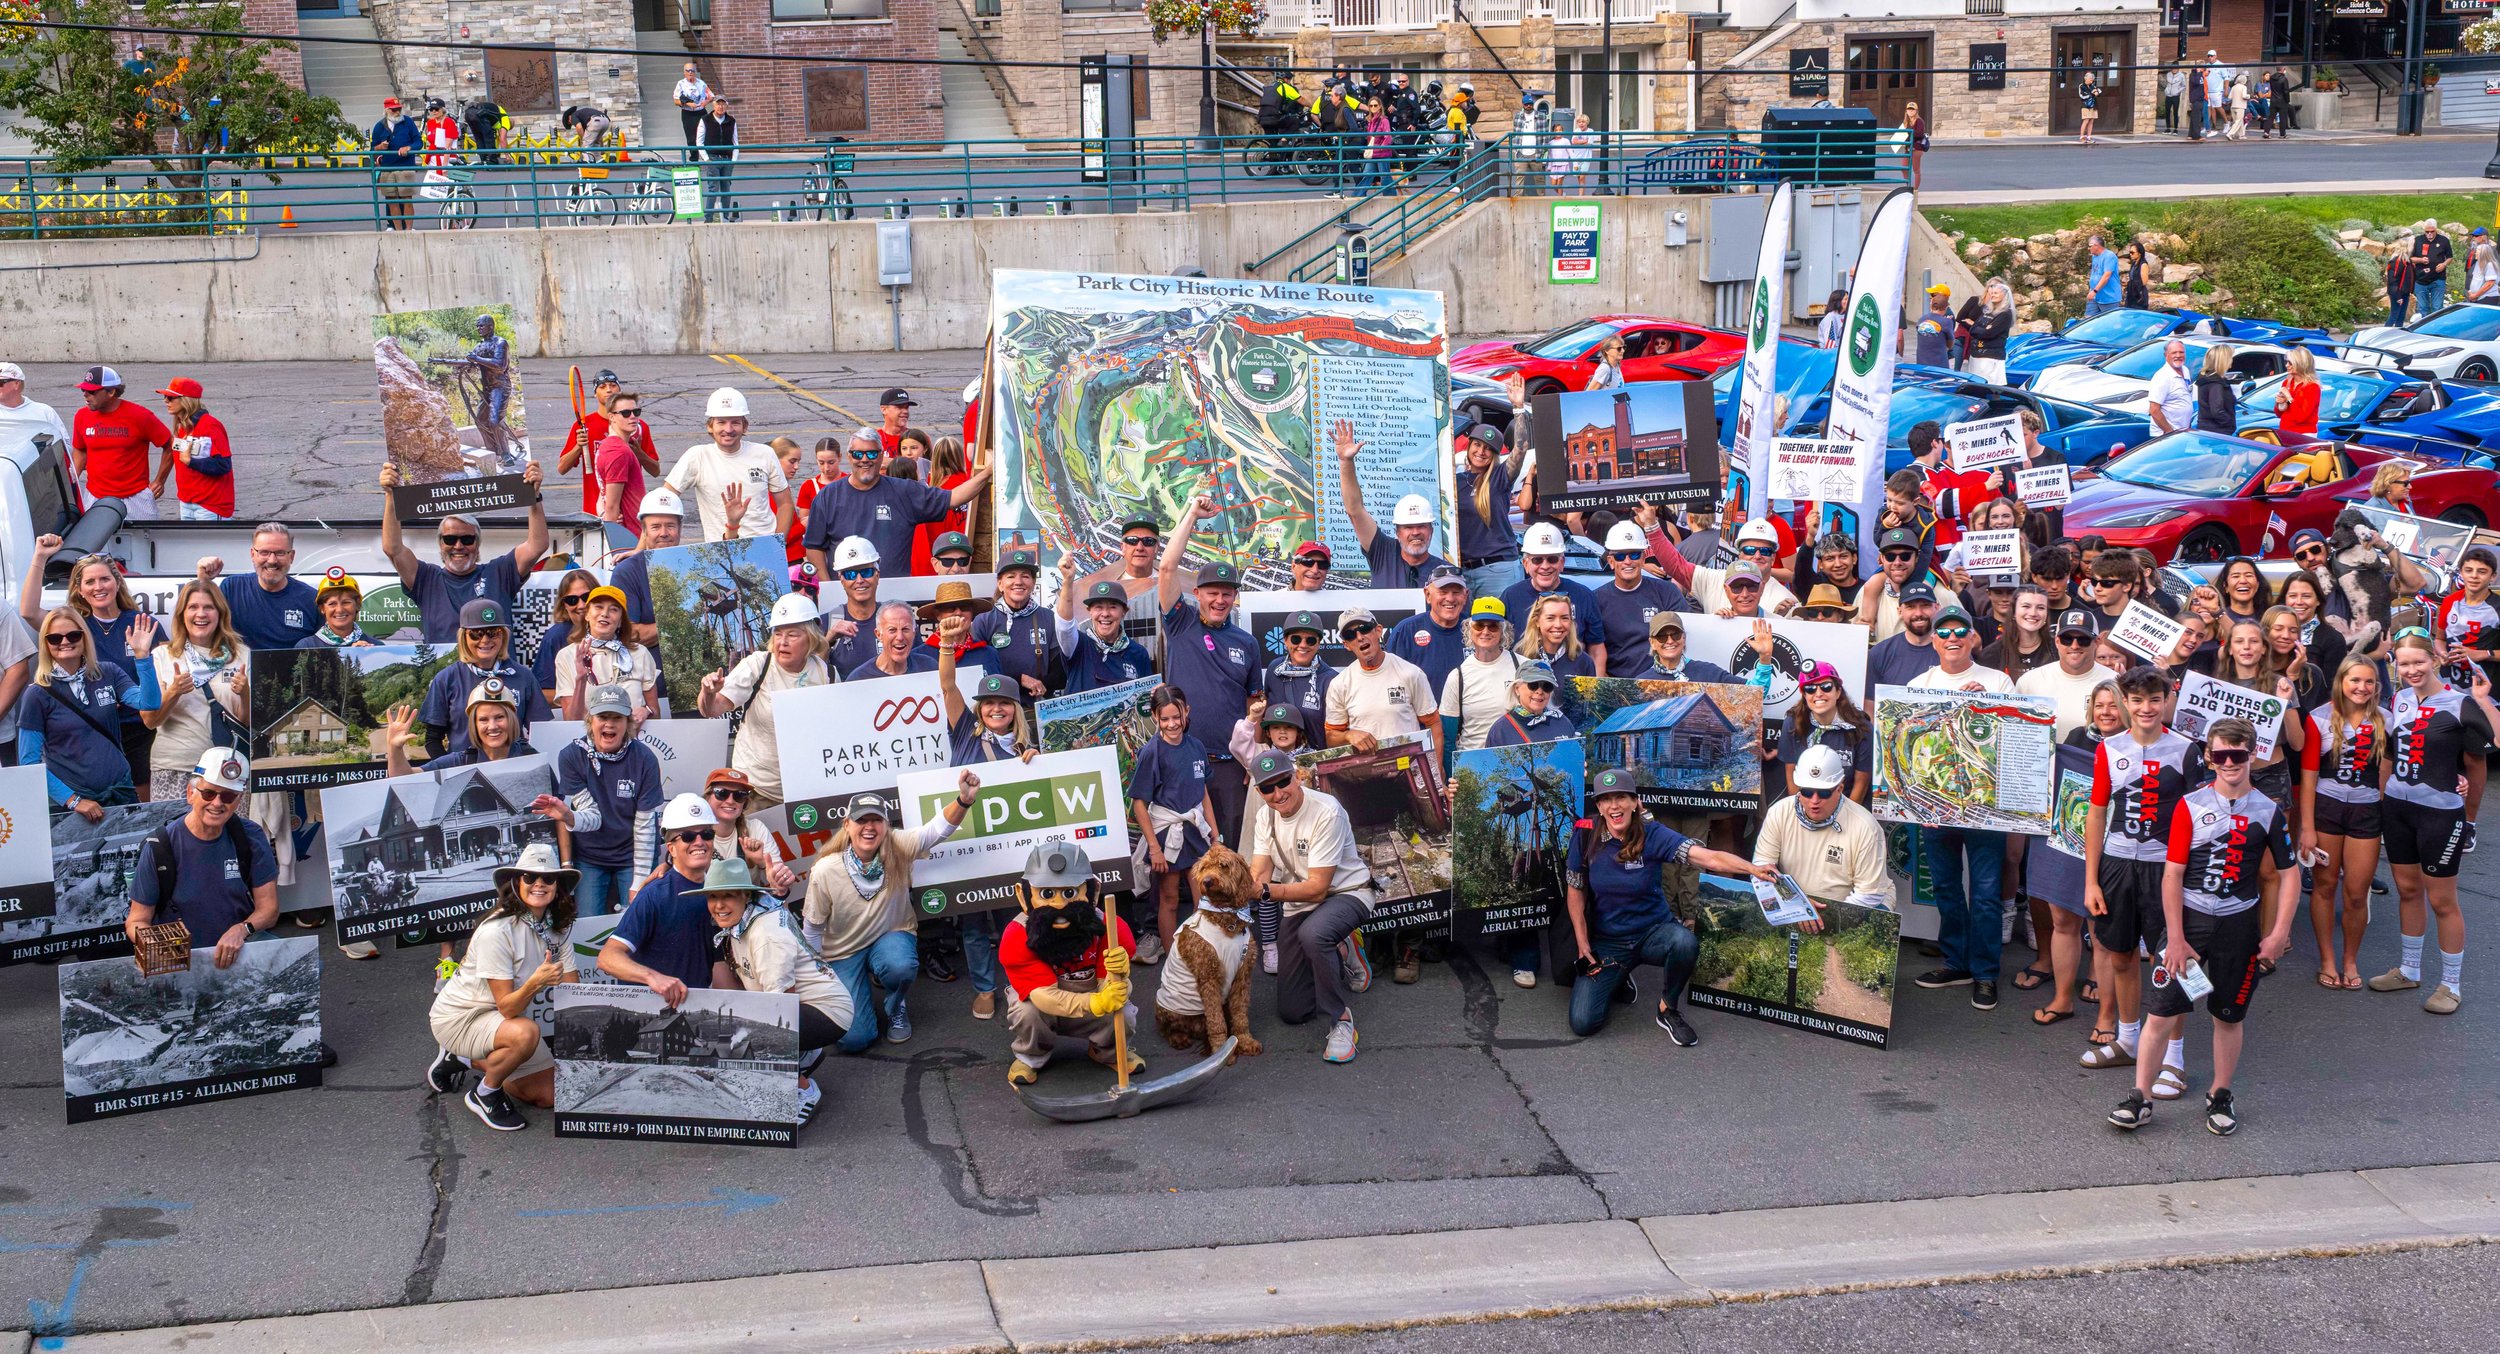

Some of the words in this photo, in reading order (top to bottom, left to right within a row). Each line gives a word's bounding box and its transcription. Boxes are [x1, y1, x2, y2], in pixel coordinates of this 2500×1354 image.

[1557, 218, 1595, 226] BREWPUB
[1077, 275, 1124, 291] Park
[1129, 278, 1170, 295] City
[1176, 280, 1255, 297] Historic
[1260, 284, 1311, 301] Mine
[1316, 288, 1375, 303] Route
[1248, 322, 1279, 333] Explore
[1280, 322, 1298, 330] Our
[1299, 319, 1321, 328] Silver
[1322, 318, 1351, 328] Mining
[1307, 330, 1339, 340] Heritage
[1355, 333, 1372, 344] This
[1374, 337, 1392, 349] New
[1346, 360, 1364, 368] City
[1367, 360, 1405, 368] Museum
[1324, 376, 1362, 384] Crescent
[1364, 377, 1405, 386] Tramway
[1387, 370, 1414, 378] Depot
[1324, 393, 1362, 401] Treasure
[1385, 396, 1427, 404] Trailhead
[1371, 404, 1412, 412] Overlook
[1975, 423, 1988, 431] STATE
[1989, 419, 2015, 428] CHAMPIONS
[1779, 442, 1815, 453] TOGETHER,
[1817, 444, 1828, 453] WE
[1829, 445, 1853, 455] CARRY
[1971, 437, 1997, 448] MINERS
[1778, 454, 1791, 463] THE
[1792, 455, 1819, 464] LEGACY
[1820, 456, 1856, 466] FORWARD.
[1966, 453, 1985, 463] BOYS
[1986, 448, 2015, 459] HOCKEY
[431, 488, 458, 498] HMR
[459, 484, 485, 494] SITE
[485, 482, 497, 491] #4
[2035, 478, 2060, 487] MINERS
[435, 499, 473, 512] MINER
[475, 494, 515, 507] STATUE
[1552, 500, 1575, 509] HMR
[1576, 498, 1597, 507] SITE
[1598, 497, 1608, 505] #1
[1616, 493, 1642, 503] PARK
[1642, 491, 1666, 501] CITY
[1668, 488, 1710, 499] MUSEUM
[2023, 490, 2065, 501] BASKETBALL
[2391, 532, 2406, 547] 10
[1984, 544, 2010, 553] MINERS
[1969, 557, 2012, 566] WRESTLING
[383, 598, 404, 608] Park
[358, 611, 394, 622] Historic
[396, 612, 422, 622] Mine
[2122, 629, 2160, 653] SOFTBALL
[2140, 624, 2169, 641] MINERS
[600, 691, 619, 700] Delta
[1040, 702, 1058, 711] Park
[1060, 697, 1077, 707] City
[1080, 689, 1110, 701] Historic
[1112, 685, 1133, 694] Mine
[1134, 678, 1158, 688] Route
[1907, 687, 1926, 695] Park
[1927, 688, 1945, 697] City
[1946, 689, 1979, 699] Historic
[1980, 692, 2001, 700] Mine
[2003, 694, 2028, 702] Route
[2207, 689, 2262, 711] MINERS
[2188, 694, 2218, 712] DIG
[2222, 704, 2274, 729] DEEP!
[2408, 706, 2435, 766] PARK
[638, 728, 677, 762] County
[822, 741, 882, 764] PARK
[890, 733, 943, 754] CITY
[2352, 724, 2373, 772] PARK
[2396, 723, 2412, 777] CITY
[824, 750, 945, 778] MOUNTAIN
[258, 776, 284, 787] HMR
[286, 774, 309, 785] SITE
[311, 773, 328, 783] #16
[335, 771, 363, 784] JM&S
[2140, 759, 2160, 823] PARK
[1729, 799, 1758, 810] CABIN
[2124, 784, 2141, 834] CITY
[1077, 825, 1106, 838] npr
[929, 851, 945, 860] 91.7
[956, 847, 974, 856] 91.9
[986, 842, 1003, 852] 88.1
[1014, 838, 1032, 848] APP
[1044, 833, 1066, 843] .ORG
[2222, 815, 2249, 882] PARK
[2439, 820, 2463, 865] MINERS
[2203, 840, 2228, 892] CITY
[1391, 902, 1415, 916] SITE
[1416, 899, 1434, 910] #24
[1486, 909, 1510, 920] HMR
[1512, 906, 1534, 917] SITE
[1536, 904, 1547, 914] #8
[347, 923, 376, 938] HMR
[378, 916, 405, 931] SITE
[407, 913, 419, 924] #2
[428, 903, 468, 921] UNION
[1397, 911, 1442, 927] TUNNEL
[1481, 921, 1519, 934] AERIAL
[1521, 916, 1550, 928] TRAM
[13, 946, 41, 959] HMR
[44, 941, 69, 954] SITE
[71, 938, 90, 948] #18
[99, 932, 127, 945] DALY
[2235, 955, 2257, 1005] MINERS
[1691, 991, 1713, 1005] HMR
[1715, 996, 1736, 1009] SITE
[1737, 1001, 1752, 1012] #13
[1759, 1006, 1799, 1024] MOTHER
[1801, 1016, 1835, 1032] URBAN
[1836, 1025, 1885, 1044] CROSSING
[94, 1098, 127, 1113] HMR
[130, 1093, 160, 1108] SITE
[162, 1090, 184, 1102] #15
[194, 1078, 259, 1098] ALLIANCE
[262, 1073, 297, 1087] MINE
[562, 1121, 587, 1133] HMR
[588, 1121, 611, 1133] SITE
[613, 1122, 629, 1134] #19
[636, 1122, 663, 1136] JOHN
[665, 1125, 692, 1137] DALY
[692, 1126, 705, 1137] IN
[707, 1127, 746, 1140] EMPIRE
[747, 1129, 791, 1142] CANYON
